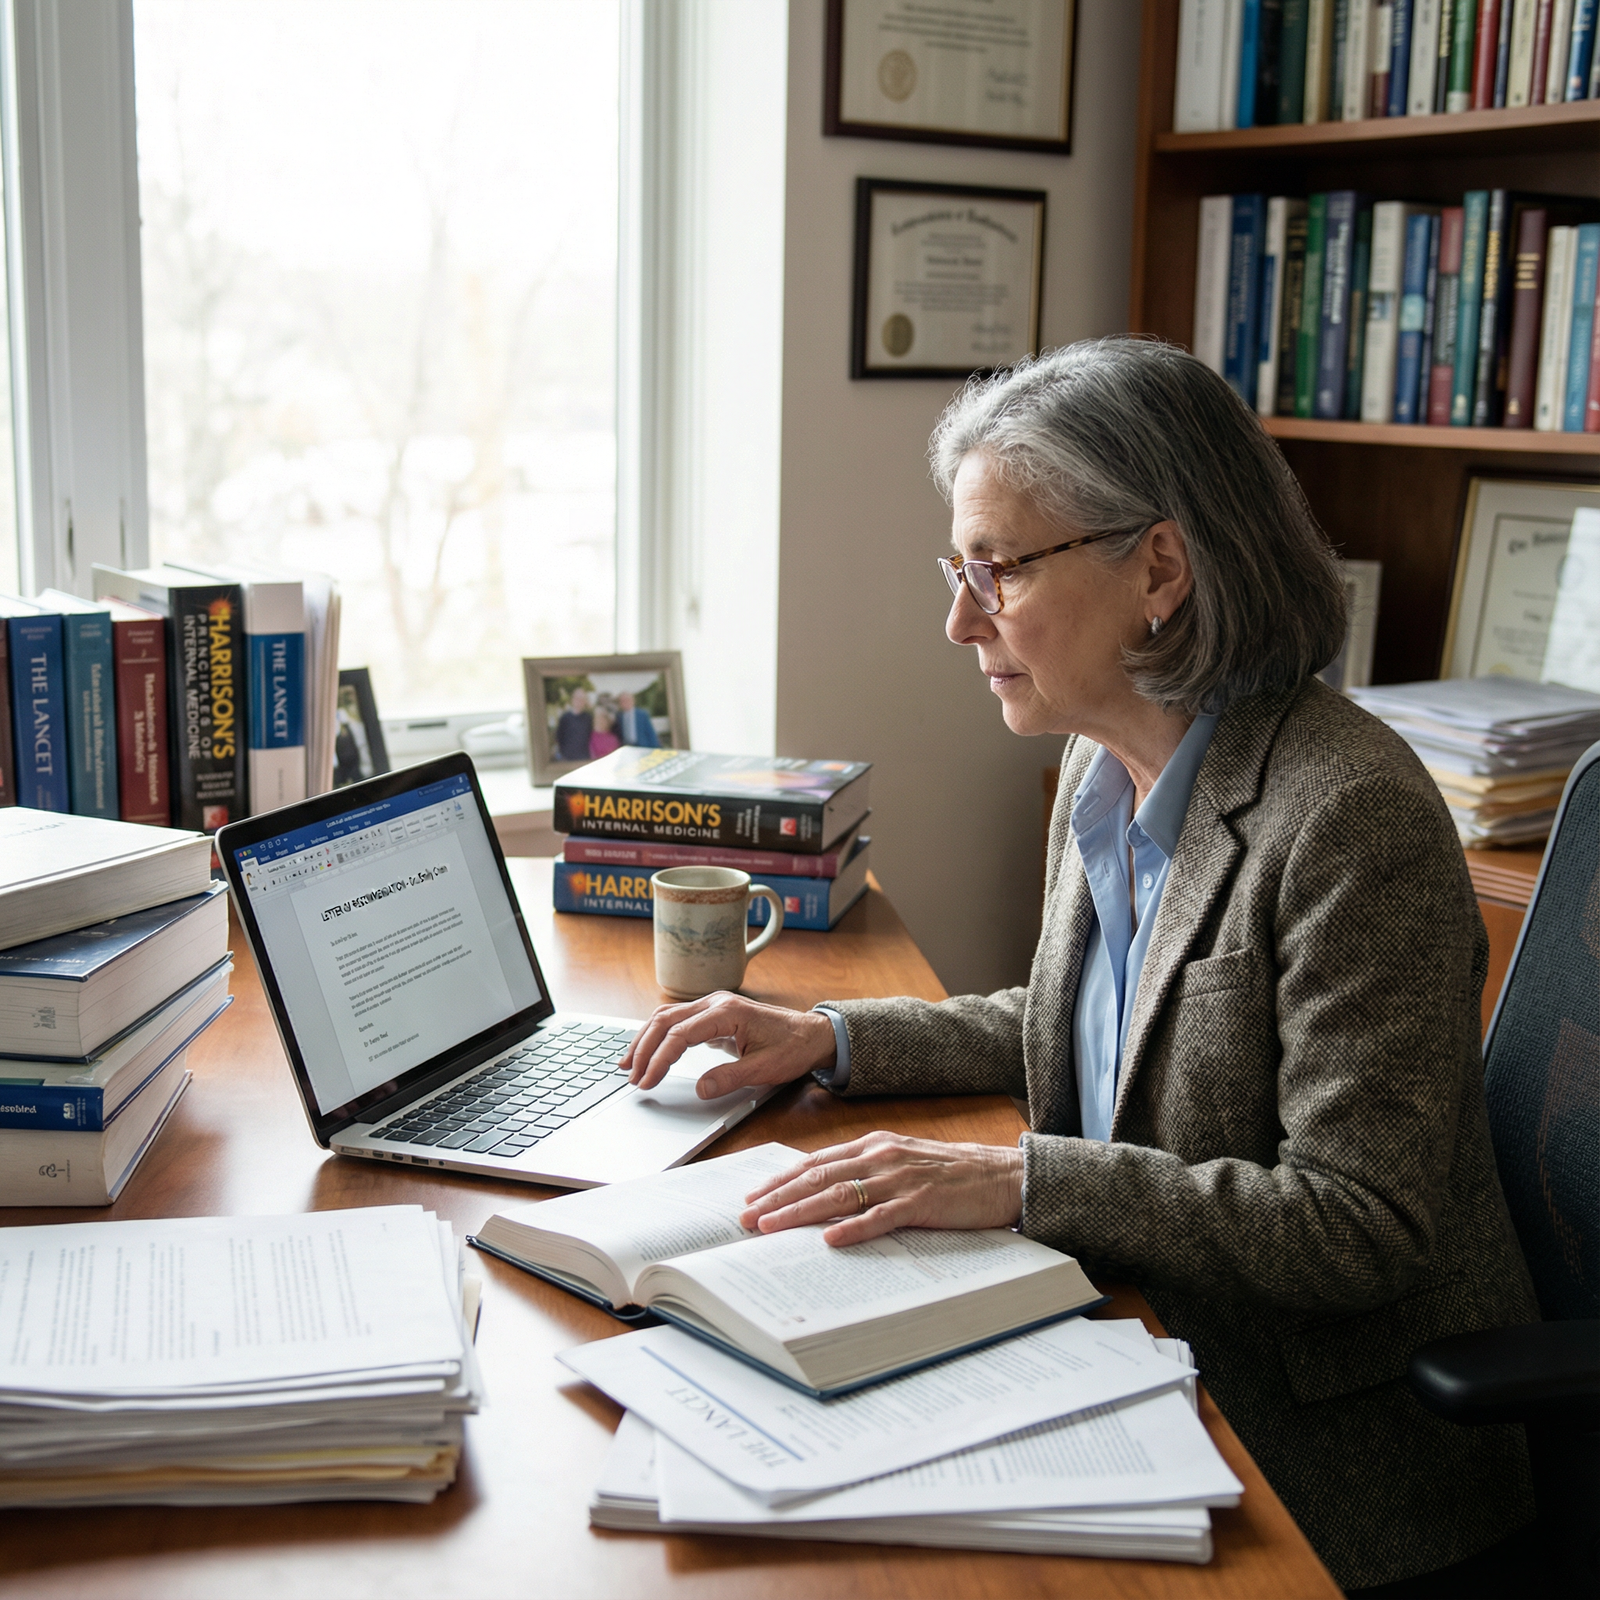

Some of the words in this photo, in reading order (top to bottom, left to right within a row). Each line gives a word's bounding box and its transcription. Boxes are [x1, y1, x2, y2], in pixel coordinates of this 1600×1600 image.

[30, 653, 49, 693] THE
[183, 615, 198, 686] INTERNAL
[197, 614, 211, 727] PRINCIPLES
[272, 639, 287, 673] THE
[210, 614, 235, 758] HARRISON'S
[273, 675, 288, 741] LANCET
[33, 698, 52, 776] LANCET
[187, 688, 202, 759] MEDICINE
[200, 737, 212, 760] OF
[582, 819, 648, 834] INTERNAL
[653, 825, 720, 839] MEDICINE
[584, 795, 721, 827] HARRISON'S
[584, 898, 650, 912] INTERNAL
[665, 1387, 748, 1440] LANCET
